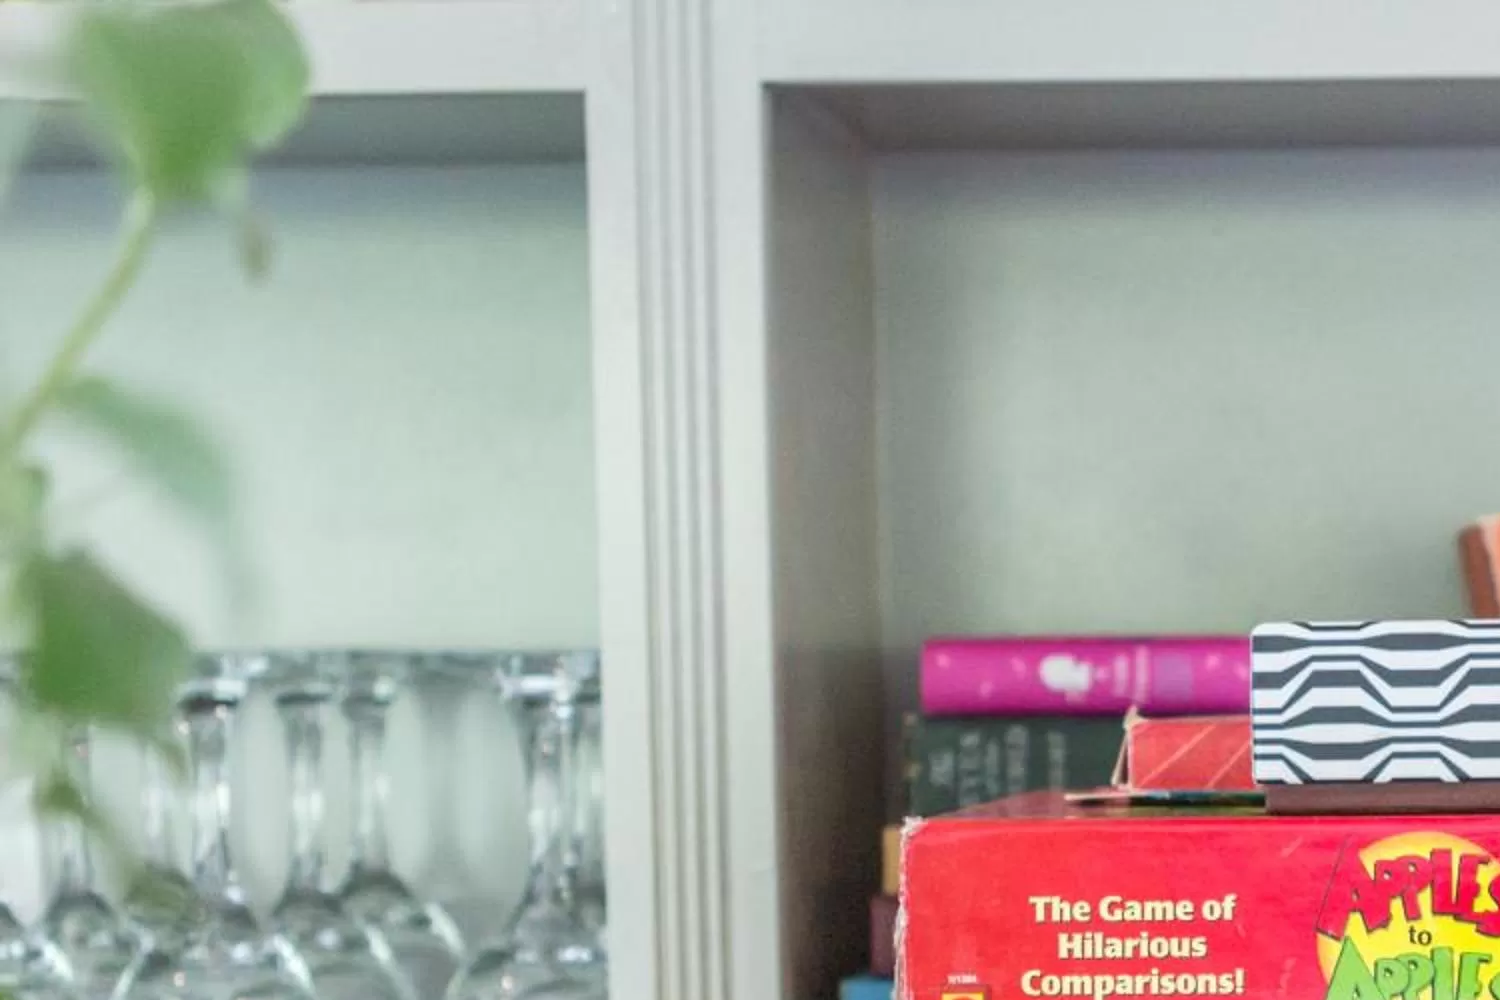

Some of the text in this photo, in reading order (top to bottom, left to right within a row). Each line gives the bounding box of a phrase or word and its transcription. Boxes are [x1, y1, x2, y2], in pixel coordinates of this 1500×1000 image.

[1029, 893, 1238, 923] The Game of
[1057, 931, 1208, 960] Hilarious
[1408, 925, 1433, 946] to
